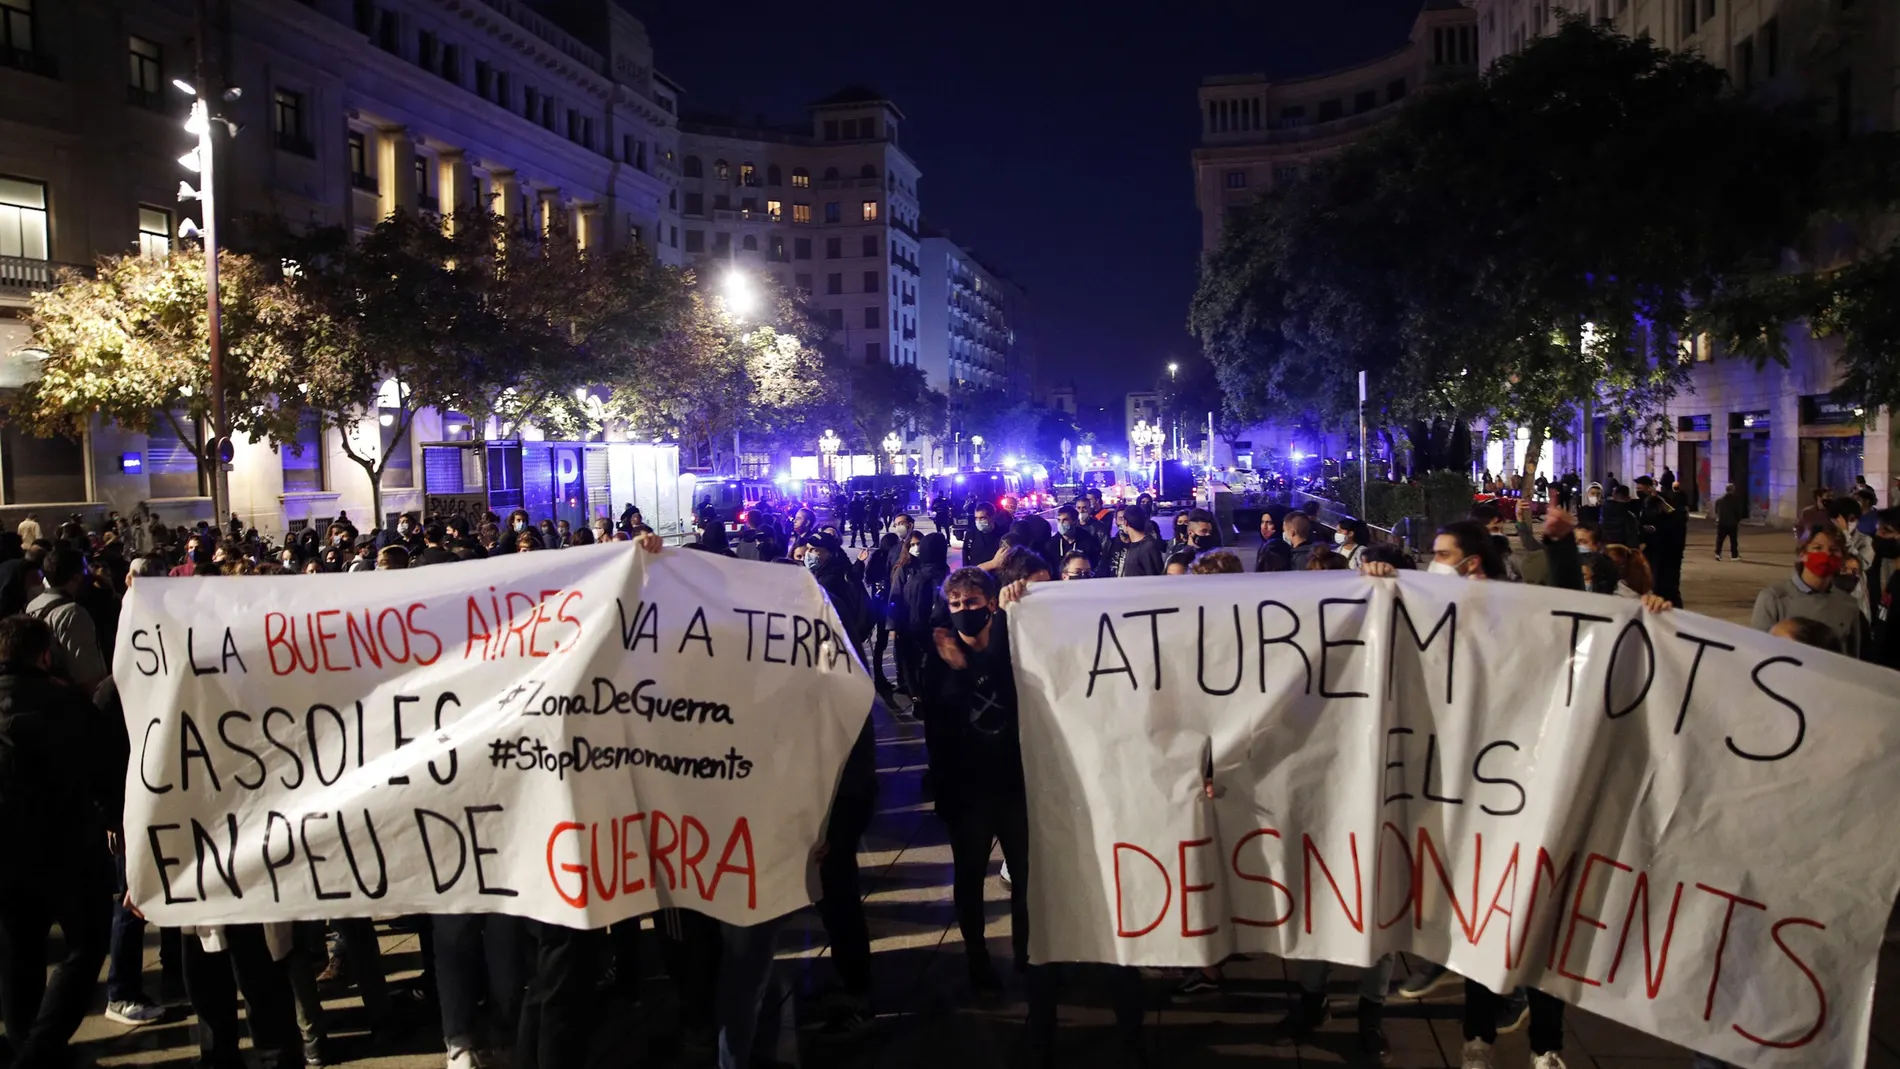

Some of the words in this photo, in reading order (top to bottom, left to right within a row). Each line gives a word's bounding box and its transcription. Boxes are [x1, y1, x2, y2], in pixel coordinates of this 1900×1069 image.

[557, 450, 579, 503] P
[187, 626, 247, 676] LA
[264, 603, 443, 676] BUENOS
[616, 598, 659, 653] VA
[678, 606, 714, 657] A
[733, 608, 853, 674] TERRA
[1086, 597, 1457, 704] ATUREM
[1551, 610, 1806, 761] TOTS
[141, 691, 462, 793] CASSOLES
[498, 677, 734, 725] #ZonaDeGuerra
[488, 736, 754, 780] #StopDesnonaments
[1384, 728, 1526, 816] ELS
[147, 813, 243, 905] EN
[262, 808, 388, 902] PEU
[414, 804, 519, 897] DE
[546, 810, 757, 910] GUERRA
[1113, 820, 1827, 1049] DESNONAMENTS
